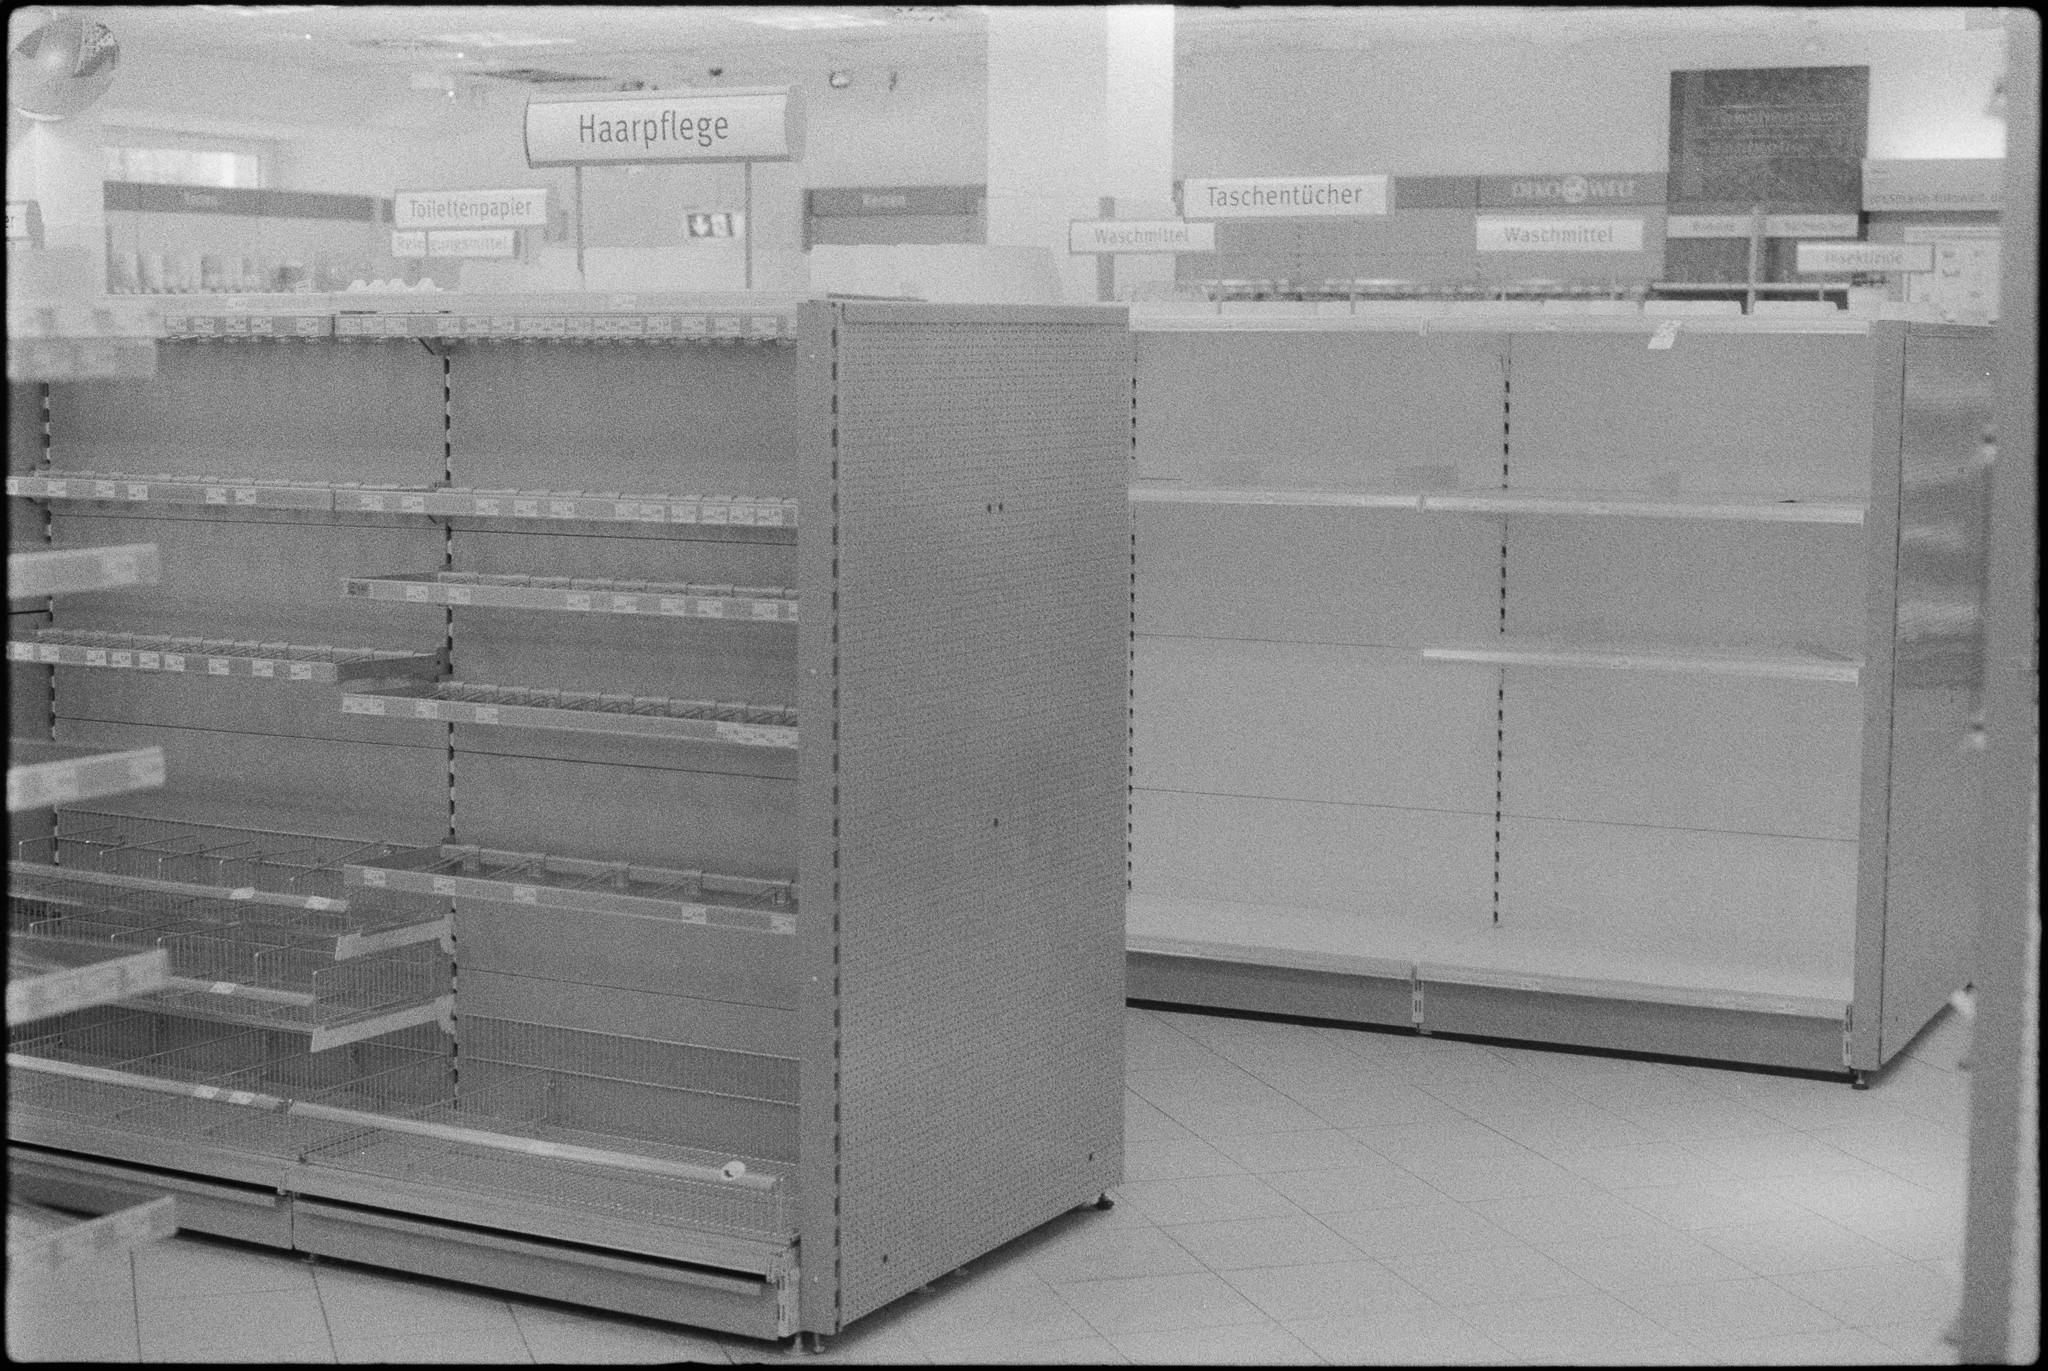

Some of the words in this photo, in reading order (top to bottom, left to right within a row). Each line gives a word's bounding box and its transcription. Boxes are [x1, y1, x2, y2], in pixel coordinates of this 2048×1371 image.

[578, 109, 729, 150] Haarpflege
[1207, 183, 1363, 207] Taschentücher
[409, 196, 532, 220] Toilettenpapier
[1094, 228, 1189, 245] Waschmittel
[1504, 226, 1613, 244] Waschmittel
